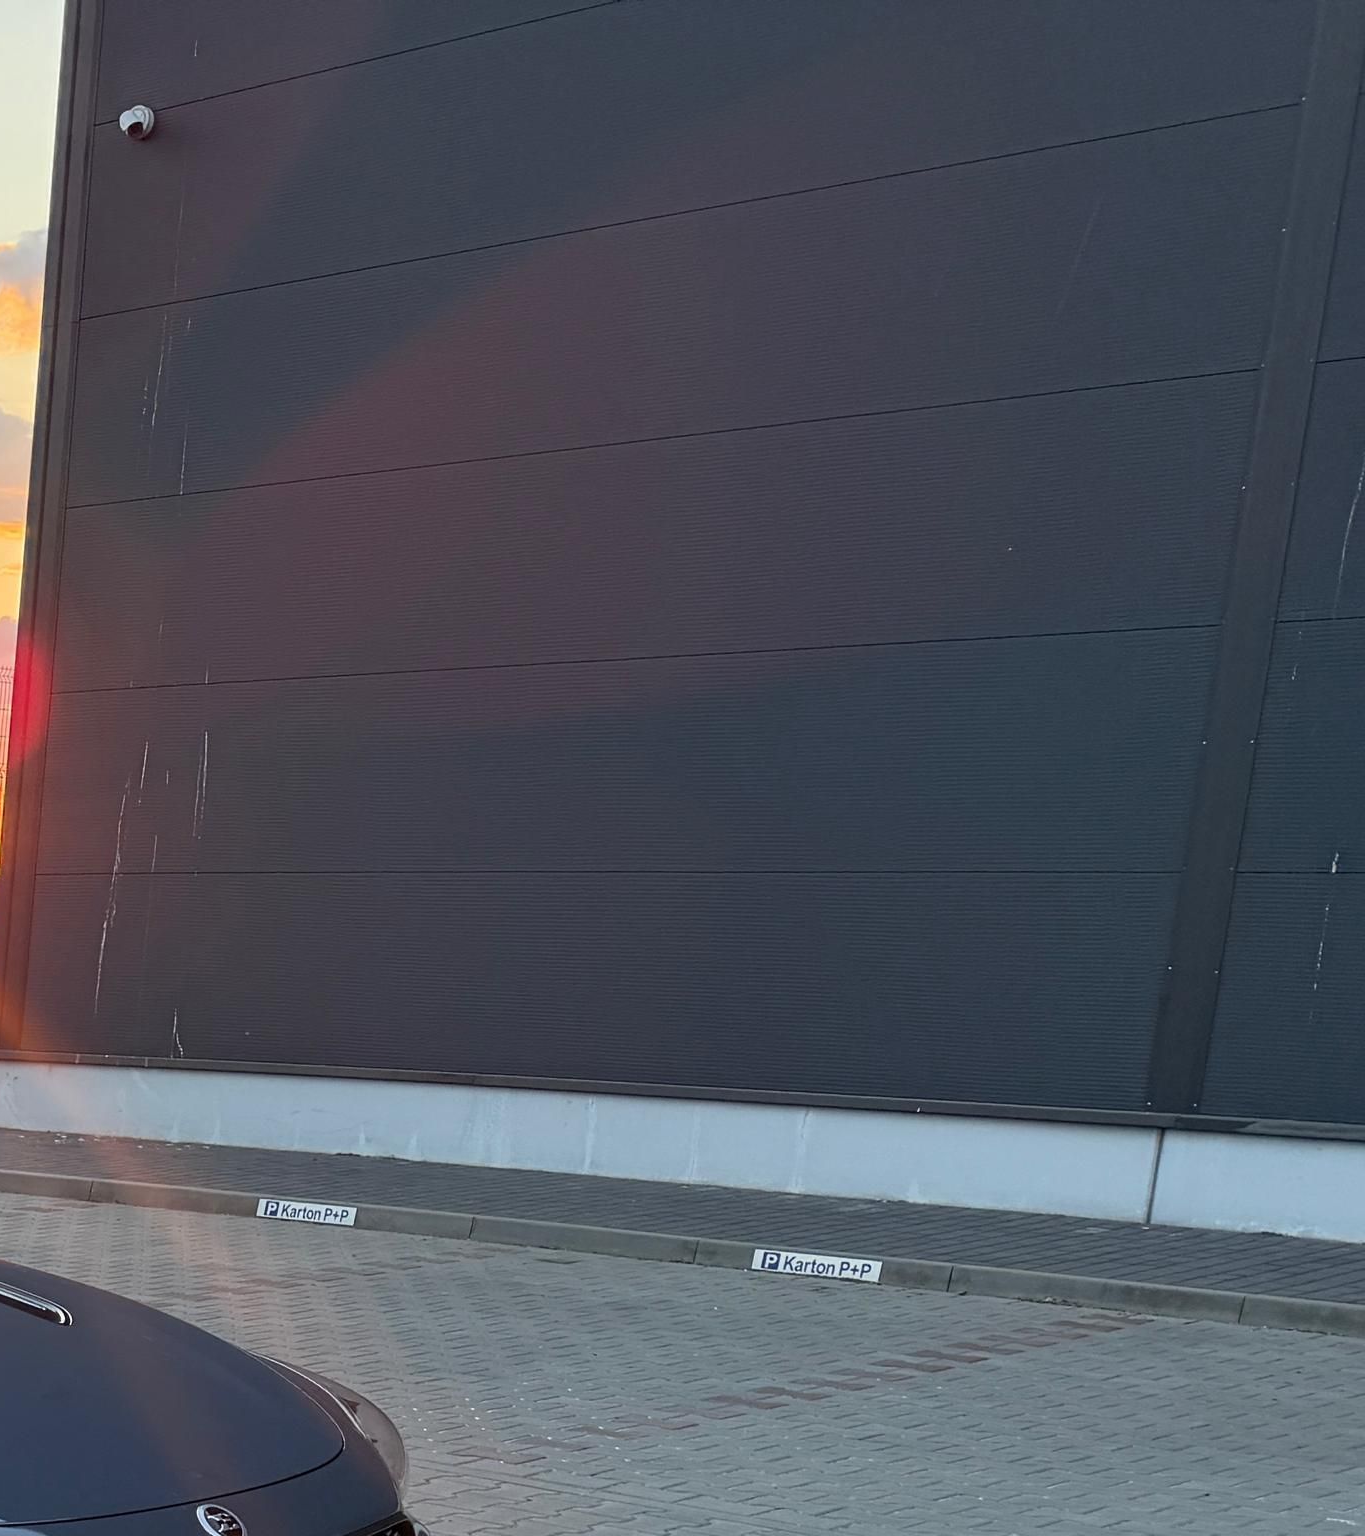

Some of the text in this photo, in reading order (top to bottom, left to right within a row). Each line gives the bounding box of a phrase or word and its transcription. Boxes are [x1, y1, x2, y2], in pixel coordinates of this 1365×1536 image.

[266, 1201, 349, 1222] P Karton P+P
[764, 1253, 872, 1278] P Karton P+P
